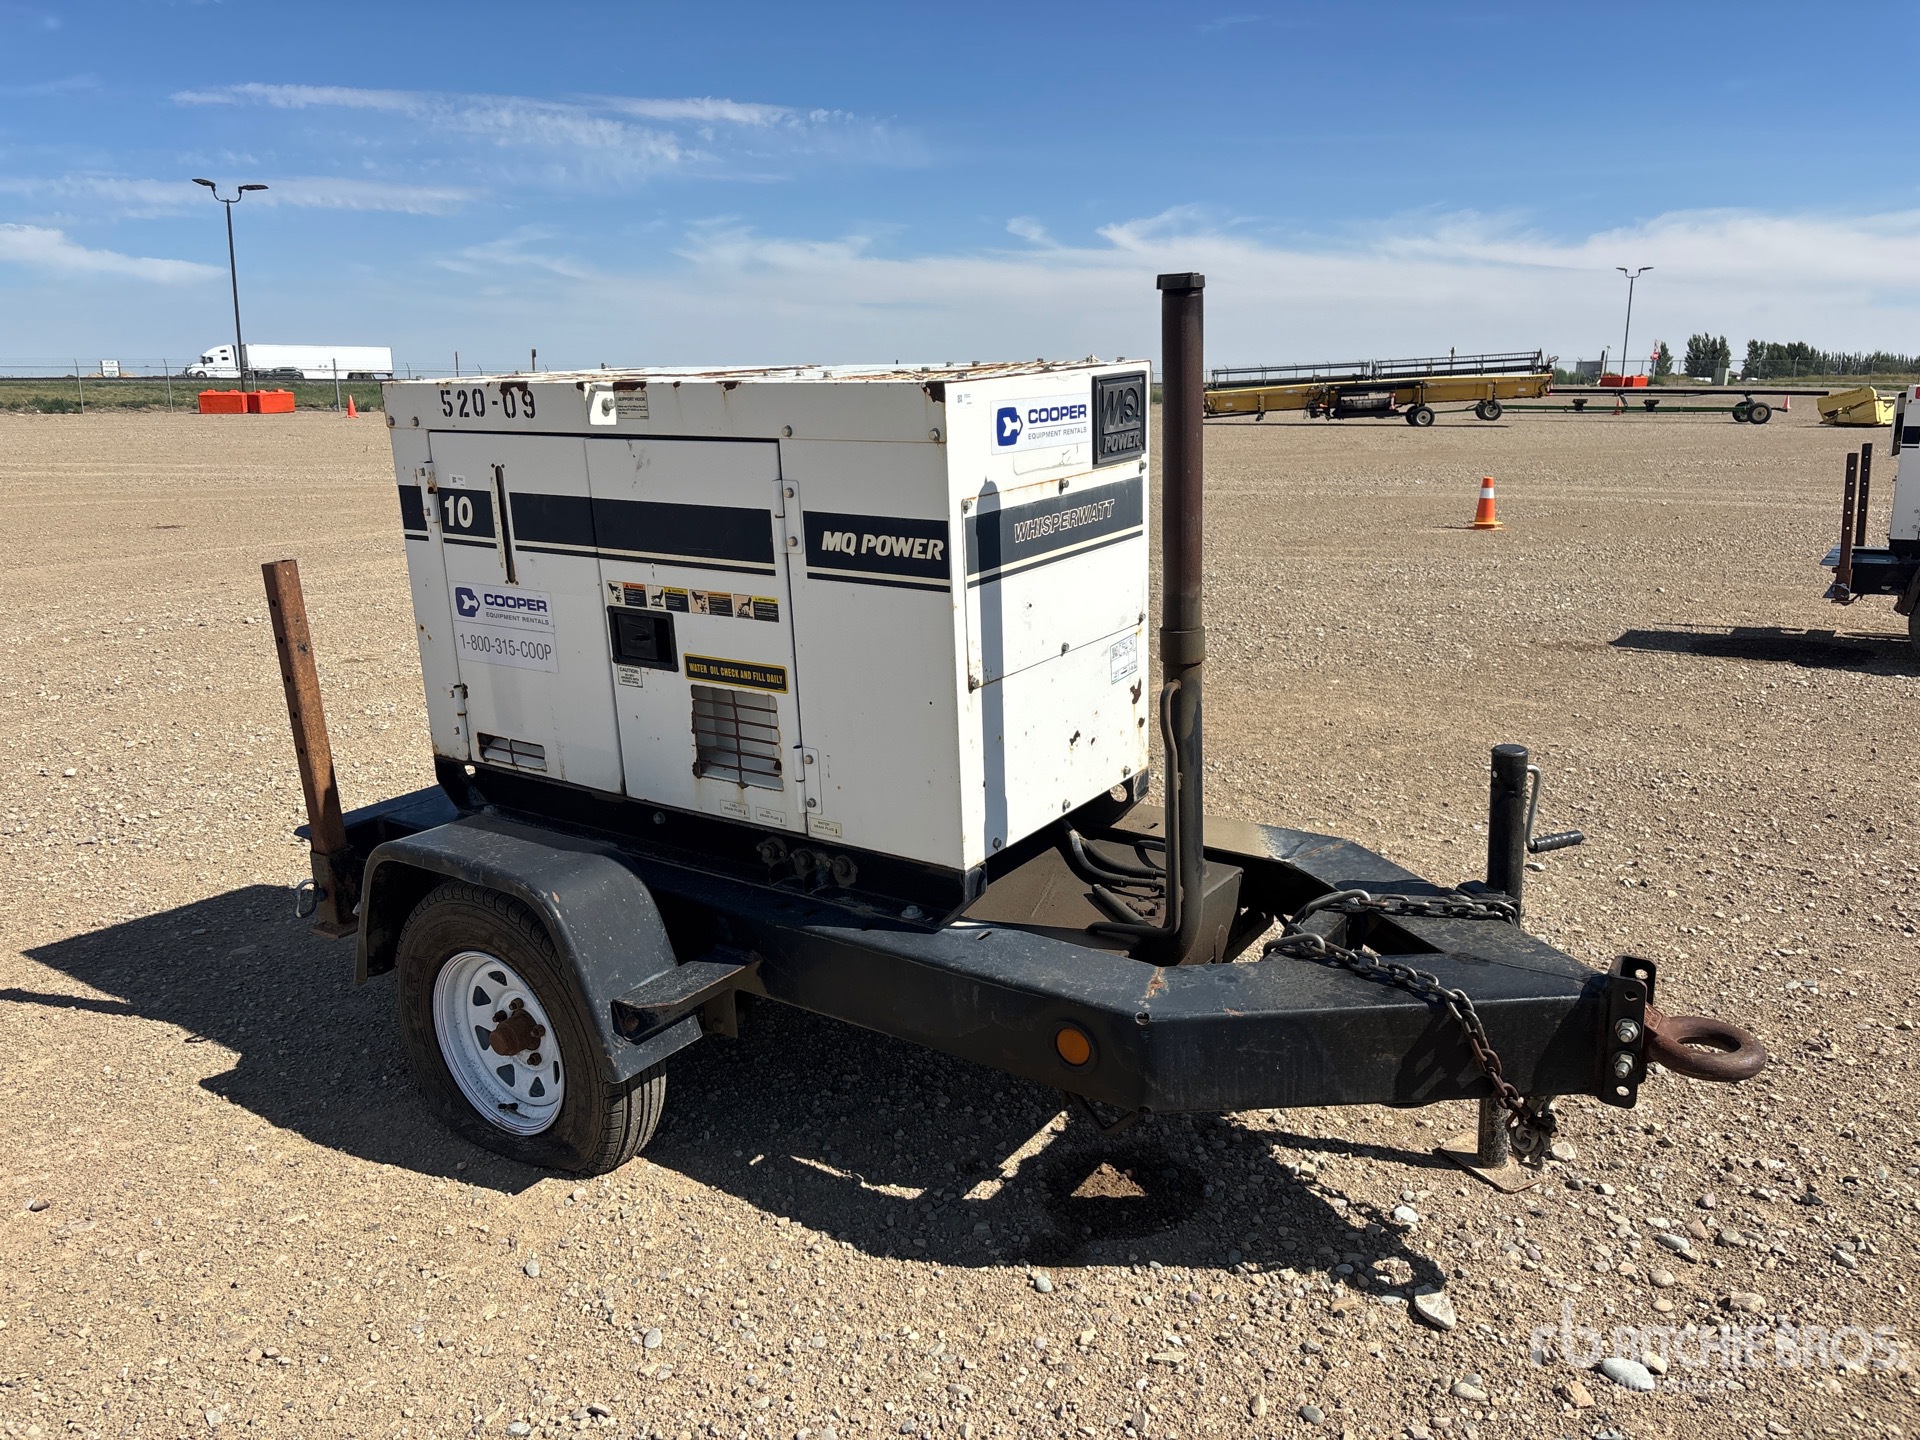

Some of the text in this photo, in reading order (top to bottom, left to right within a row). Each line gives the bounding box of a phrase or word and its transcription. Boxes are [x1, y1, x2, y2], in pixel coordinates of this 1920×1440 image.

[440, 388, 536, 419] 520-09
[1028, 404, 1087, 424] COOPER
[1101, 387, 1141, 427] MQ
[1028, 426, 1087, 440] EQUIPMENT RENTALS
[1103, 431, 1141, 454] POWER
[444, 495, 474, 528] 10
[1014, 499, 1115, 543] WHISPERWATT
[821, 531, 945, 561] MQ POWER
[484, 593, 548, 612] COOPER
[486, 612, 549, 626] EQUIPMENT RENTALS
[460, 633, 552, 661] 1-800-315-COOP
[689, 662, 783, 685] WATER OIL CHECK AND FILL DAILY
